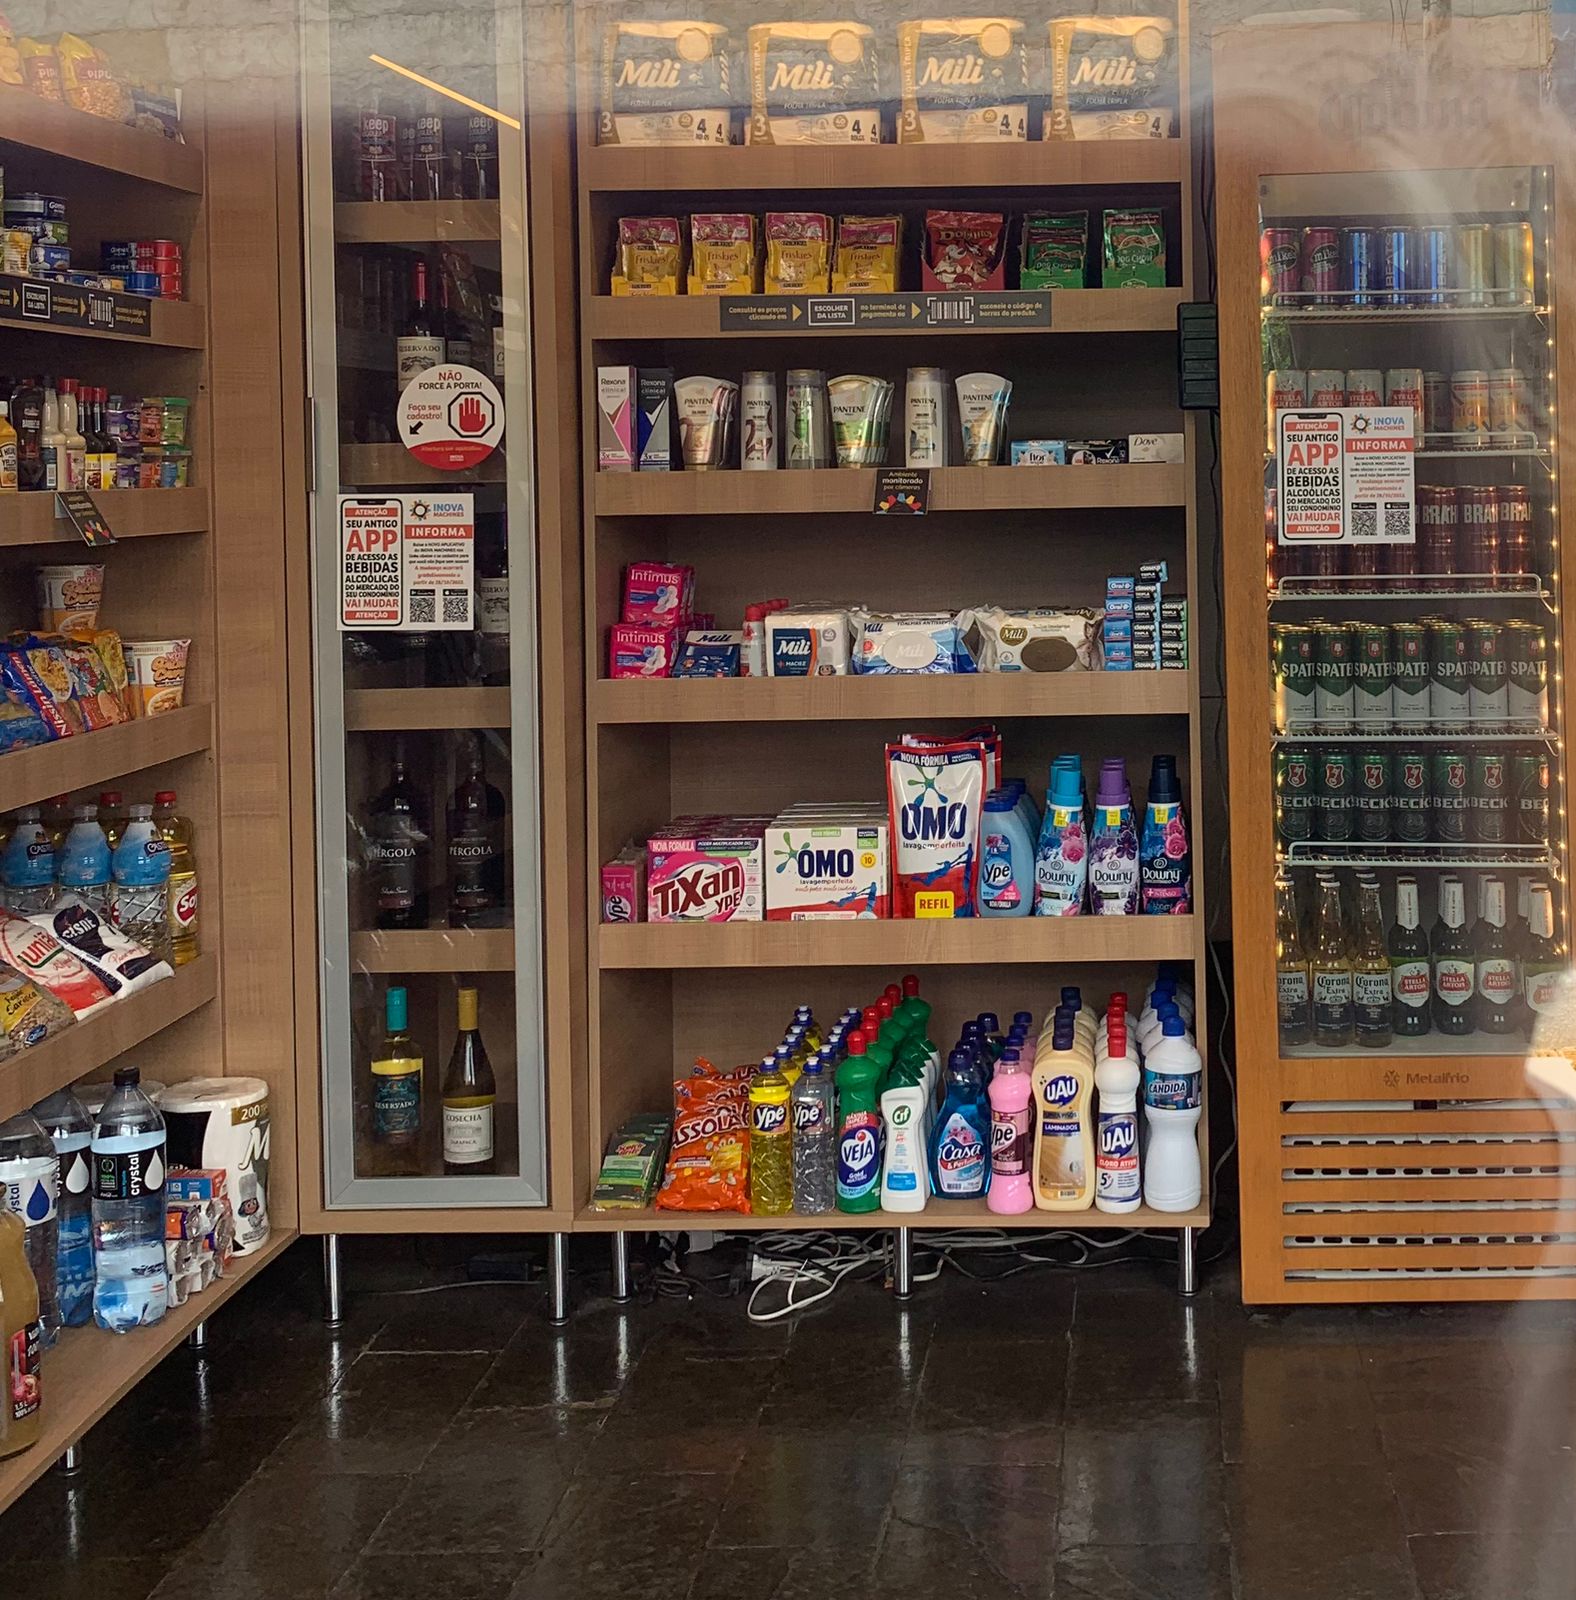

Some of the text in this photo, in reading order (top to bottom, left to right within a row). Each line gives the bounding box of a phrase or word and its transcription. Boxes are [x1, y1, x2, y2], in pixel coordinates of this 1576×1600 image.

[615, 59, 681, 88] Mili
[768, 60, 833, 90] Mili
[920, 55, 984, 85] Mili
[1071, 55, 1136, 86] Mili
[601, 112, 612, 133] 3
[697, 119, 707, 134] 4
[754, 114, 766, 136] 3
[905, 110, 917, 131] 3
[1001, 114, 1010, 130] 4
[1054, 109, 1066, 130] 3
[1152, 117, 1161, 132] 4
[852, 119, 862, 135] 4
[814, 304, 848, 312] ESCOLHER
[438, 370, 463, 381] NÃO
[601, 378, 626, 386] Rexona
[641, 379, 666, 387] Rexona
[408, 403, 426, 411] Faça
[407, 412, 443, 420] cadastro!
[1374, 417, 1405, 425] INOVA
[1295, 423, 1328, 432] ATENÇÃO
[1134, 436, 1158, 446] Dove
[1287, 434, 1339, 442] SEU ANTIGO
[1352, 440, 1407, 450] INFORMA
[1287, 443, 1339, 466] APP
[1298, 467, 1327, 475] ACESSO
[882, 477, 924, 485] monitorado
[1286, 476, 1339, 487] BEBIDAS
[355, 508, 388, 517] ATENÇÃO
[433, 503, 464, 512] INOVA
[1287, 512, 1341, 521] VAI MUDAR
[346, 520, 398, 528] SEU ANTIGO
[1296, 525, 1330, 533] ATENÇÃO
[411, 527, 466, 536] INFORMA
[346, 529, 398, 552] APP
[357, 553, 387, 561] ACESSO
[345, 562, 398, 573] BEBIDAS
[631, 569, 679, 585] Intimus
[345, 599, 399, 608] VAI MUDAR
[355, 611, 388, 619] ATENÇÃO
[617, 631, 665, 644] Intimus
[1002, 629, 1024, 639] Mili
[776, 639, 811, 655] Mili
[901, 752, 920, 764] NOVA
[920, 754, 949, 766] FÓRMULA
[902, 802, 967, 840] OMO
[798, 849, 853, 878] OMO
[985, 864, 1010, 883] Ype
[1038, 868, 1076, 886] Downy
[1095, 870, 1132, 884] Downy
[1142, 867, 1180, 883] Downy
[919, 898, 950, 910] REFIL
[1317, 976, 1350, 988] Corona
[1355, 976, 1389, 988] Corona
[1406, 1072, 1470, 1085] Metalfrio
[1046, 1075, 1077, 1101] UAU
[241, 1106, 260, 1121] 200
[756, 1106, 785, 1128] Ype
[794, 1106, 819, 1126] Ype
[894, 1107, 910, 1123] Cif
[1045, 1123, 1078, 1131] LAMINADOS
[1102, 1122, 1135, 1152] UAU
[843, 1140, 873, 1162] VEJA
[942, 1144, 981, 1161] Casa
[128, 1154, 142, 1196] crystal
